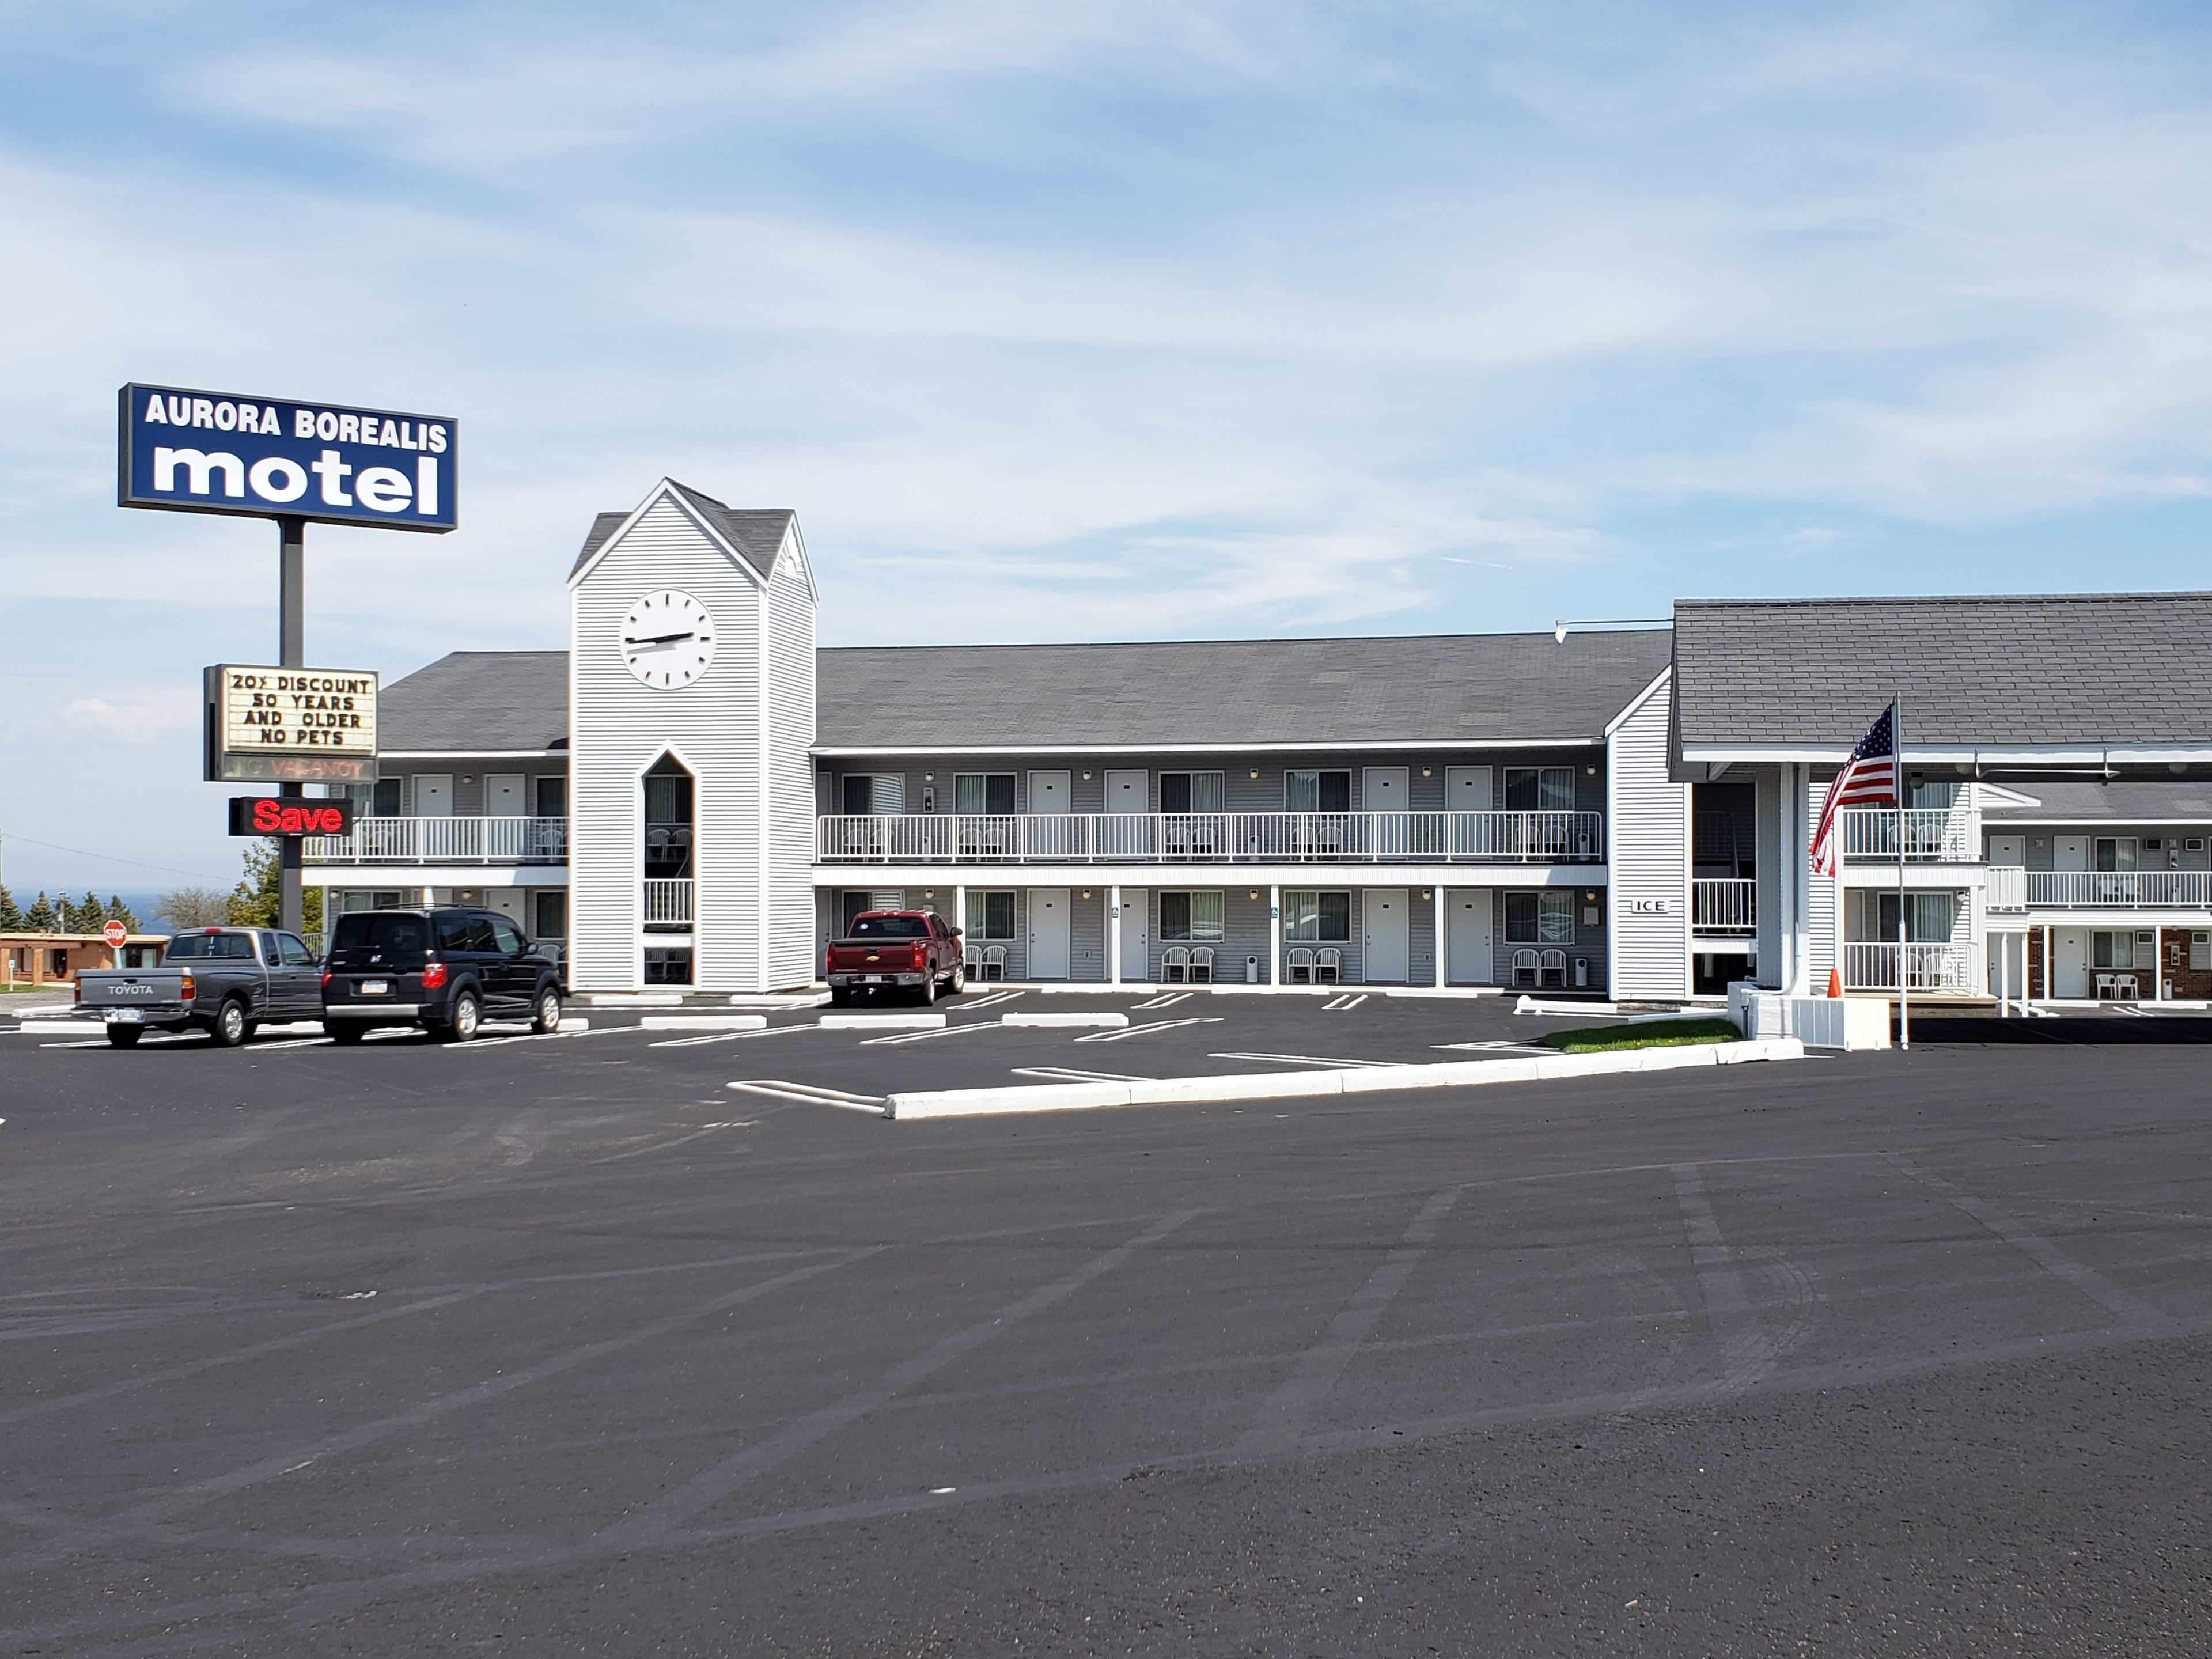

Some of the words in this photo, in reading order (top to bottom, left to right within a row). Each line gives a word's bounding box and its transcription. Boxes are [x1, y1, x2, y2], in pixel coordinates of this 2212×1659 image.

[145, 393, 282, 436] AURORA
[295, 410, 448, 454] BOREALIS
[154, 446, 438, 516] motel
[278, 676, 369, 694] DISCOUNT
[253, 693, 277, 707] 50
[292, 694, 354, 710] YEARS
[244, 710, 282, 725] AND
[302, 713, 360, 728] OLDER
[261, 729, 286, 743] NO
[297, 729, 343, 745] PETS
[252, 800, 342, 831] Save
[1637, 900, 1665, 911] ICE
[105, 929, 125, 940] STOP
[108, 986, 154, 995] TOYOTA
